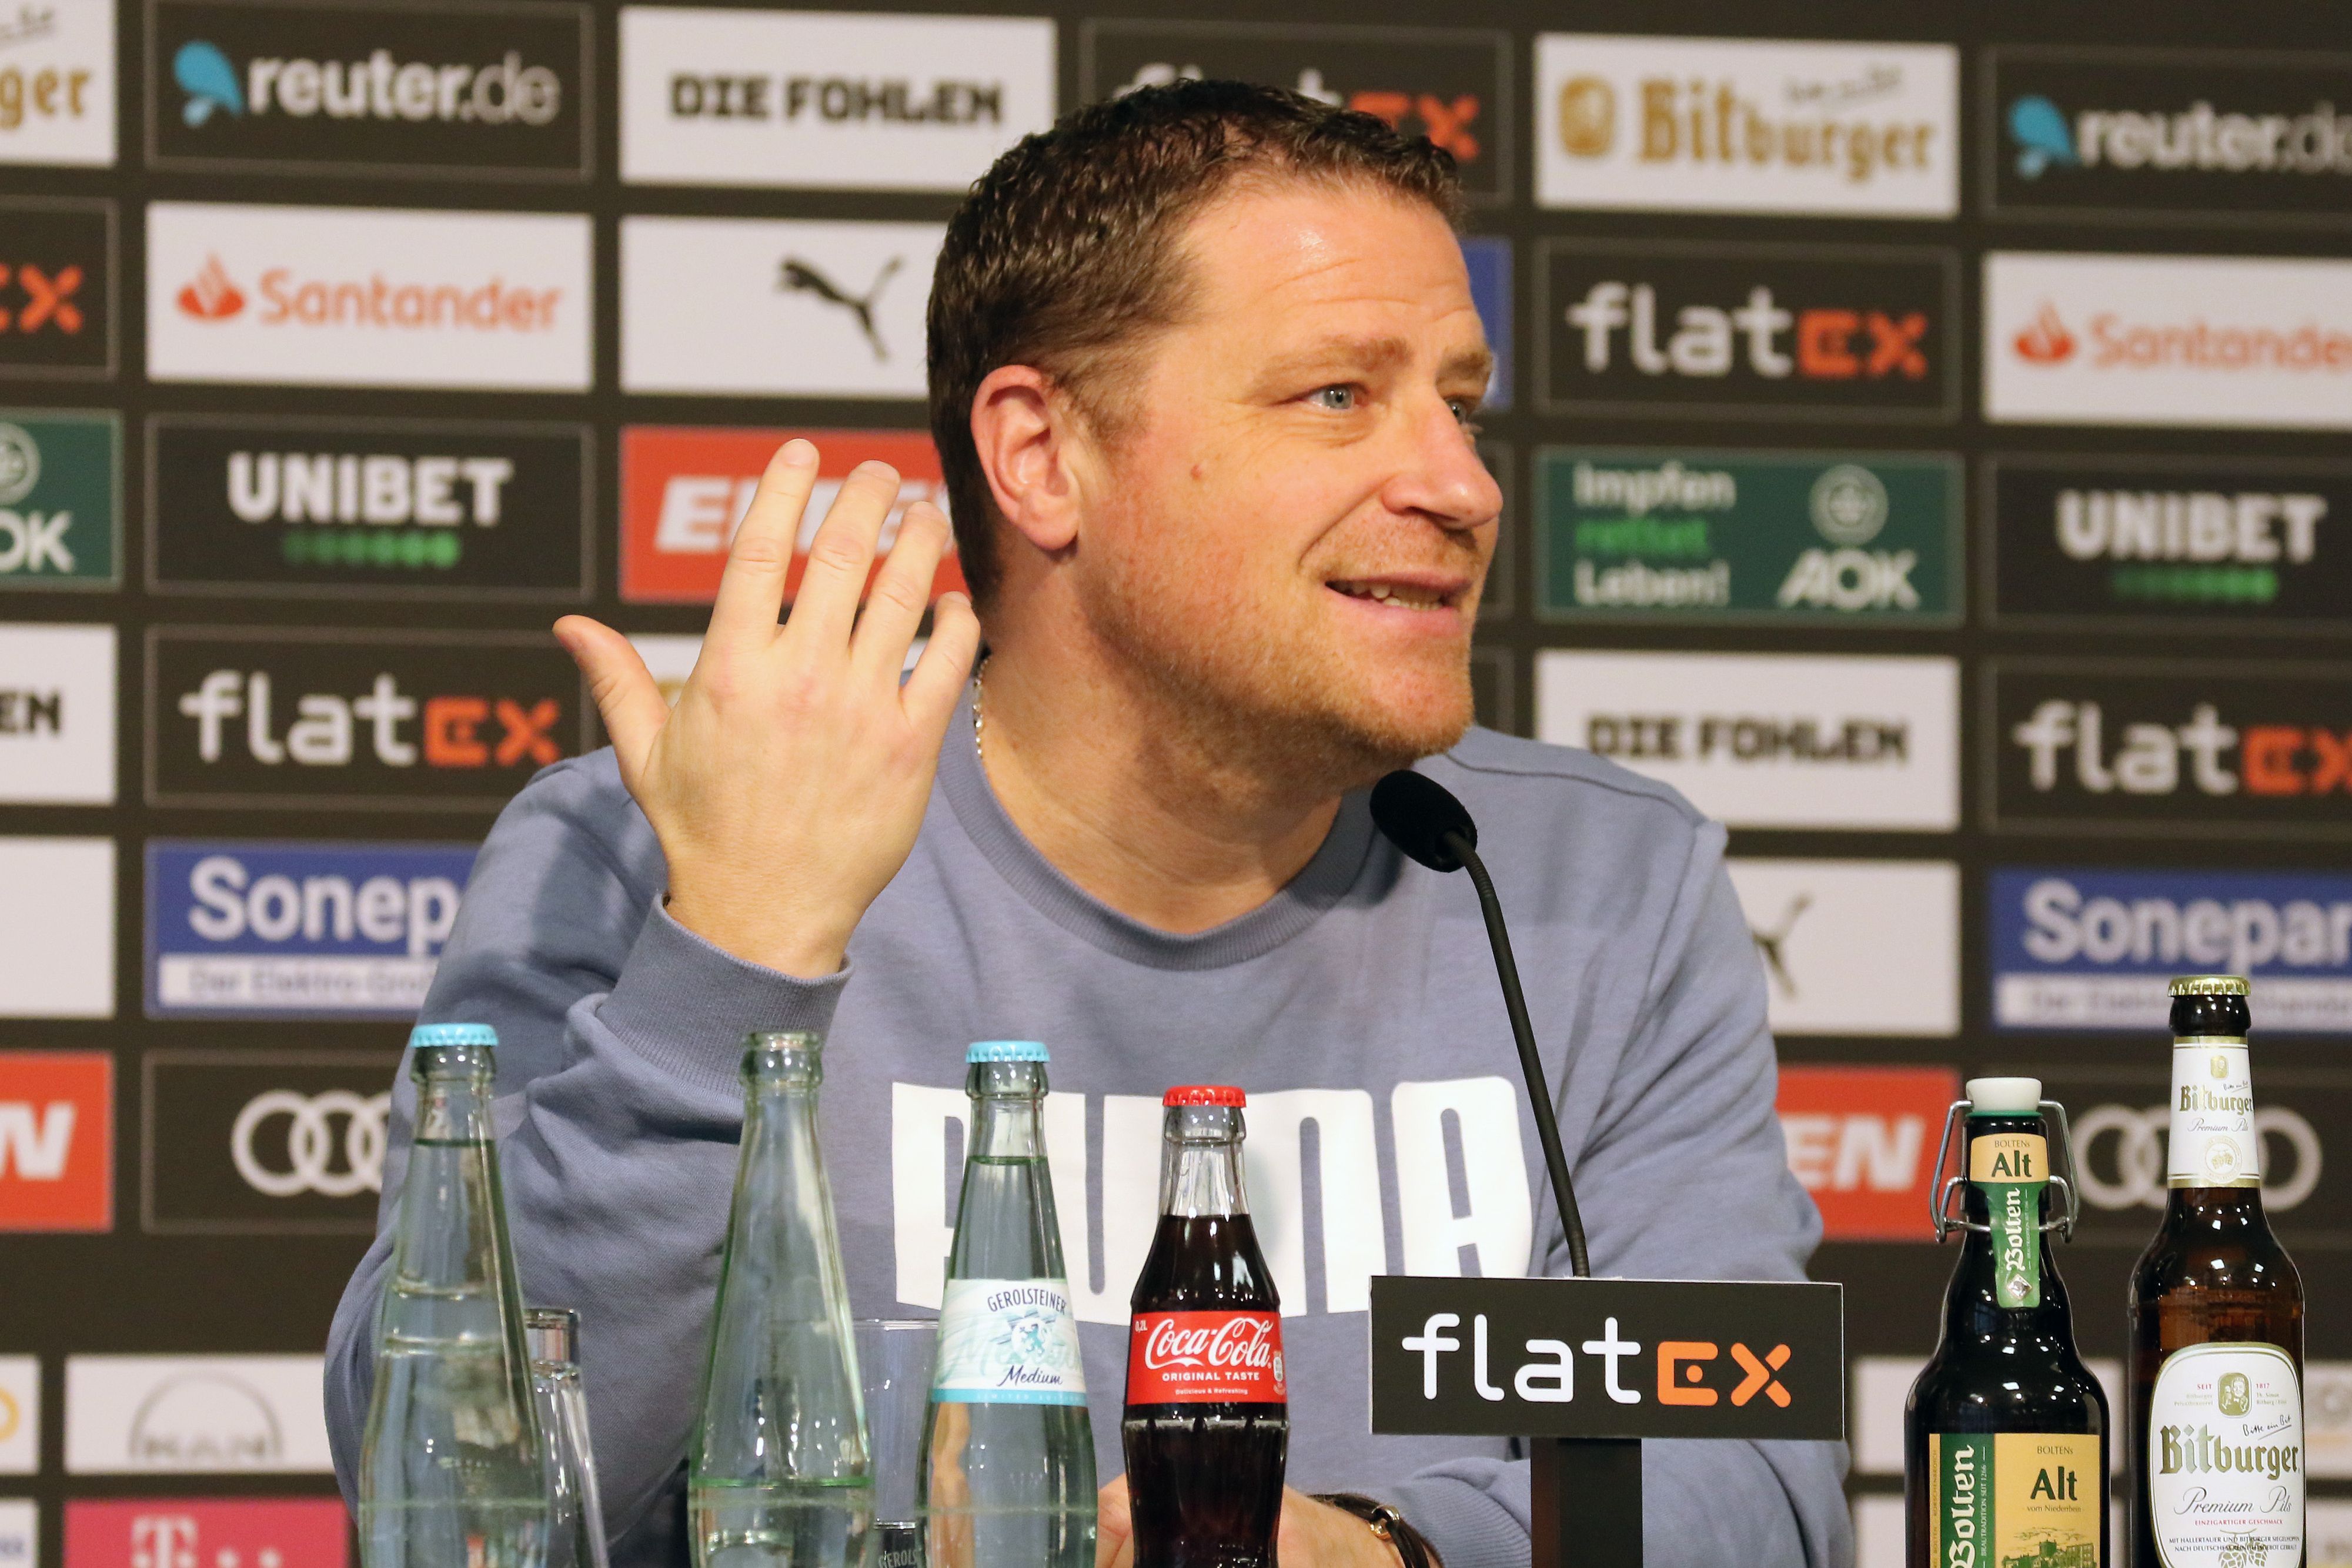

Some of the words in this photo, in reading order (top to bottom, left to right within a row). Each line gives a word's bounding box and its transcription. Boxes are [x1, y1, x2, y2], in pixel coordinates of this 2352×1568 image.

[247, 49, 562, 125] reuter.de
[672, 73, 768, 119] DIE
[787, 76, 1003, 124] FOHLEN
[1639, 79, 1933, 182] Bitburger
[259, 269, 562, 330] Santander
[228, 452, 513, 526] UNIBET
[2057, 489, 2327, 564] UNIBET
[1779, 548, 1920, 611] AOK
[1588, 718, 1678, 758] DIE
[1698, 720, 1907, 764] FOHLEN
[2180, 1085, 2254, 1115] Bitburger
[1991, 1150, 2032, 1178] Alt
[2004, 1188, 2026, 1272] Bolten
[987, 1288, 1067, 1315] GEROLSTEINER
[1145, 1317, 1274, 1370] Coca-Cola
[997, 1365, 1063, 1387] Medium
[1162, 1372, 1220, 1382] ORIGINAL
[1225, 1372, 1260, 1380] TASTE
[2159, 1423, 2300, 1480] Bitburger
[2243, 1423, 2264, 1437] Bitte
[2280, 1414, 2291, 1426] Bit
[1948, 1444, 1976, 1568] Bolten
[2030, 1466, 2077, 1501] Alt
[2173, 1486, 2254, 1515] Premium
[2259, 1486, 2292, 1513] Pils
